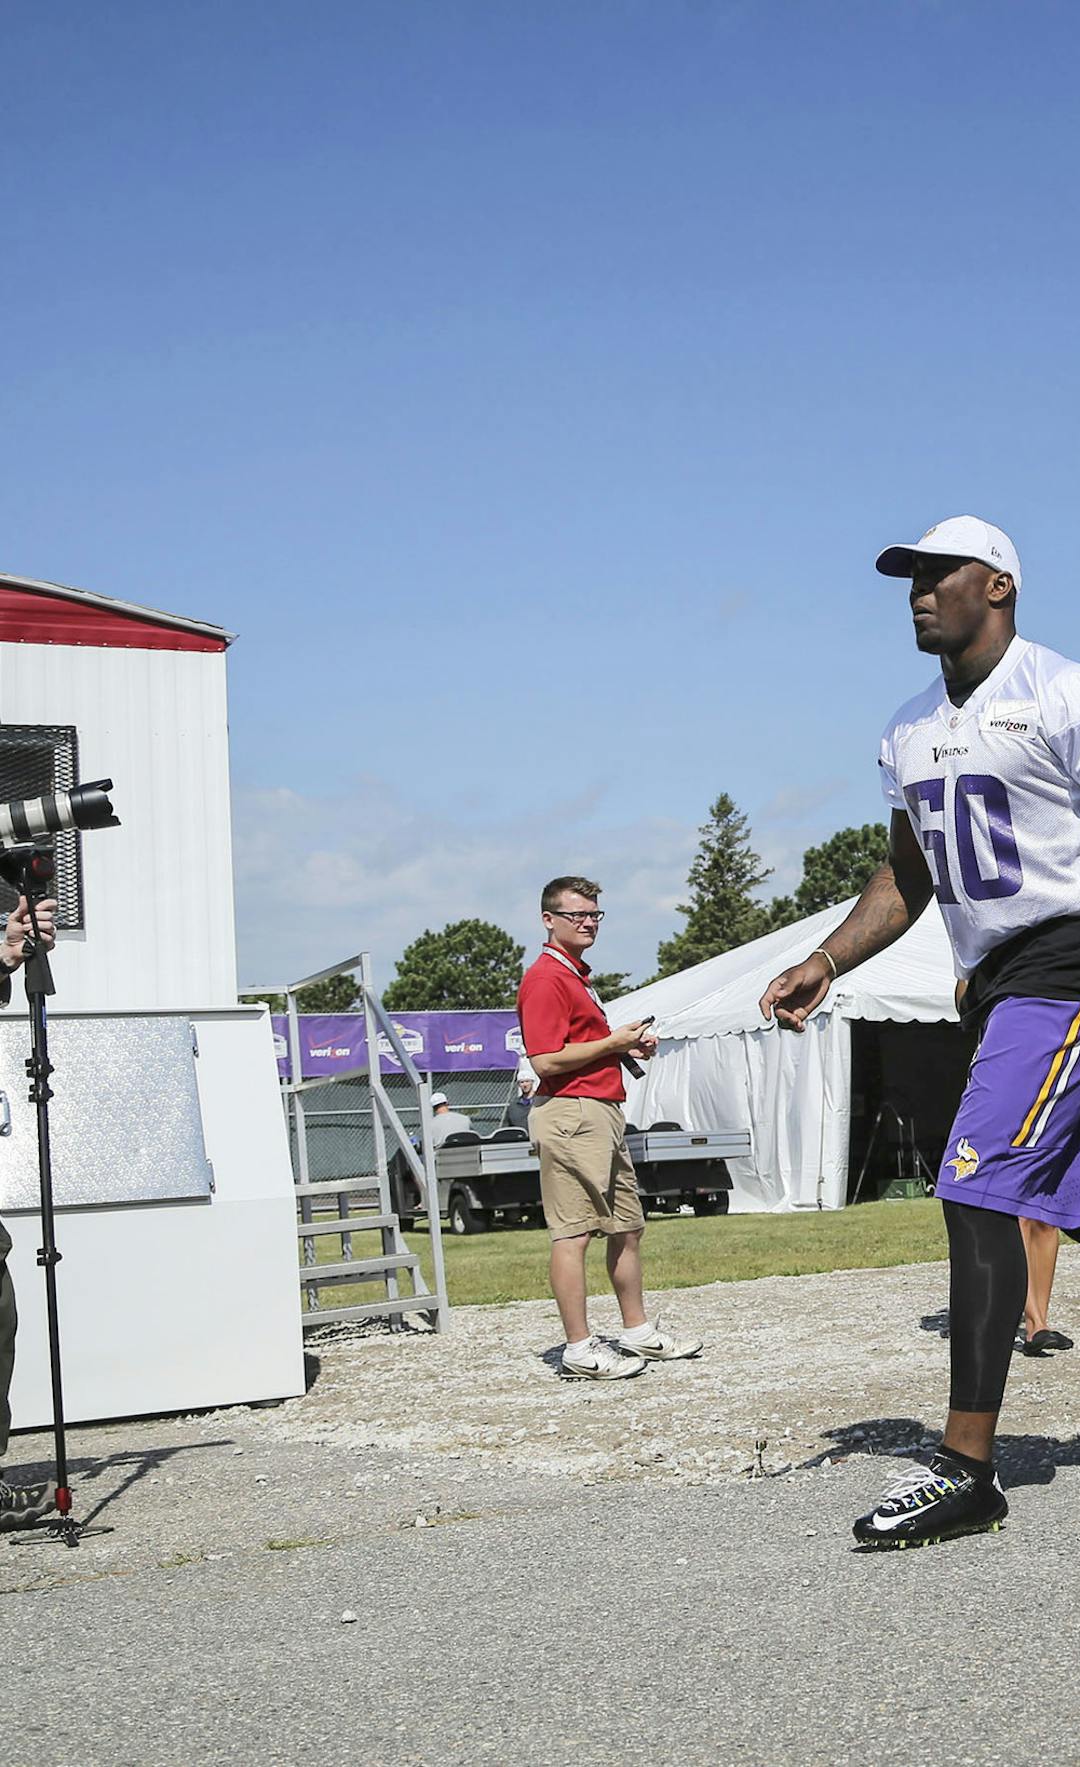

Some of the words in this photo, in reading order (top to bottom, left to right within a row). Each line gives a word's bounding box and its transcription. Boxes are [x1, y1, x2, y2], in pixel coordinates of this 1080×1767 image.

[989, 718, 1028, 734] verizon
[309, 1046, 351, 1058] verizon
[445, 1042, 483, 1055] verizon
